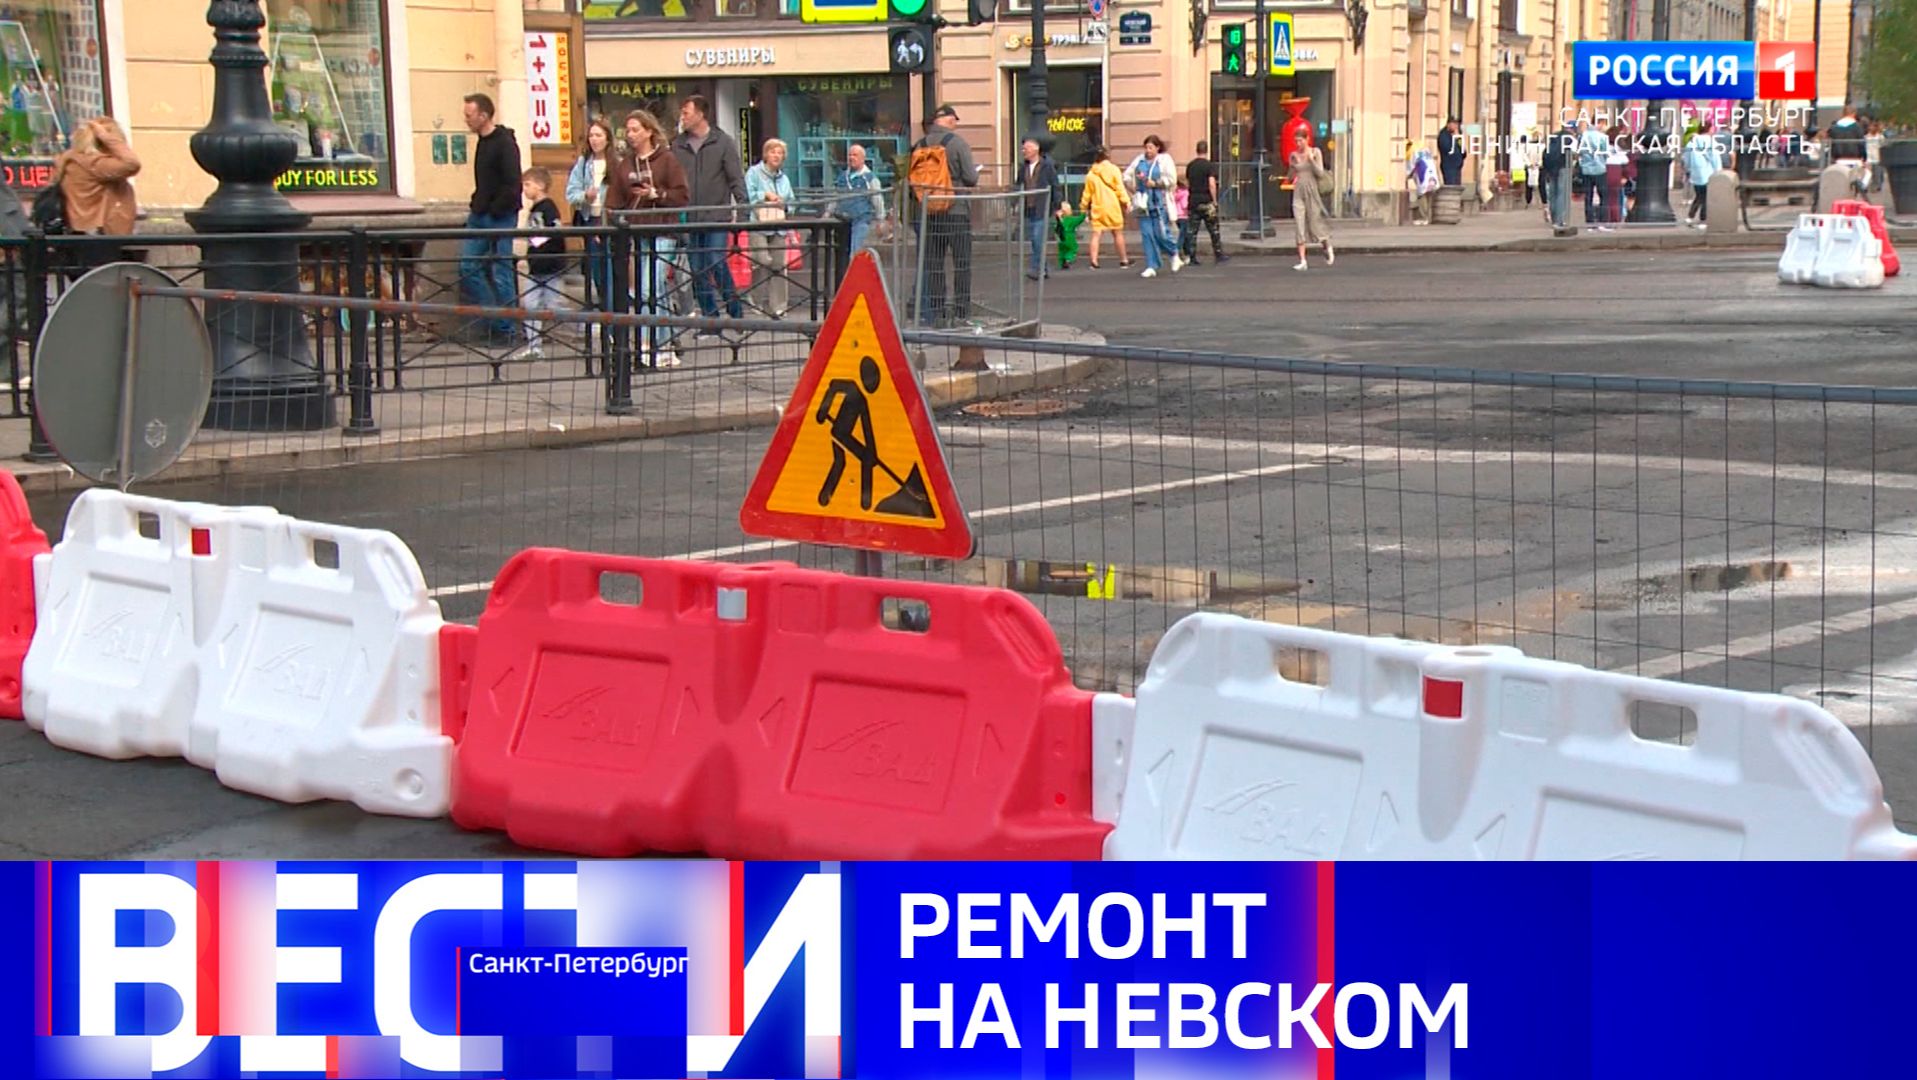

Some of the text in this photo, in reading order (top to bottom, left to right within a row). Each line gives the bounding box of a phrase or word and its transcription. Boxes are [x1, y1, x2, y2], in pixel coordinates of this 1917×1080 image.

[685, 47, 776, 67] СУВЕНИРЫ
[556, 36, 571, 142] SOUVENIRS
[599, 82, 676, 96] ПОДАРКИ
[305, 170, 337, 186] FOR
[341, 170, 378, 186] LESS
